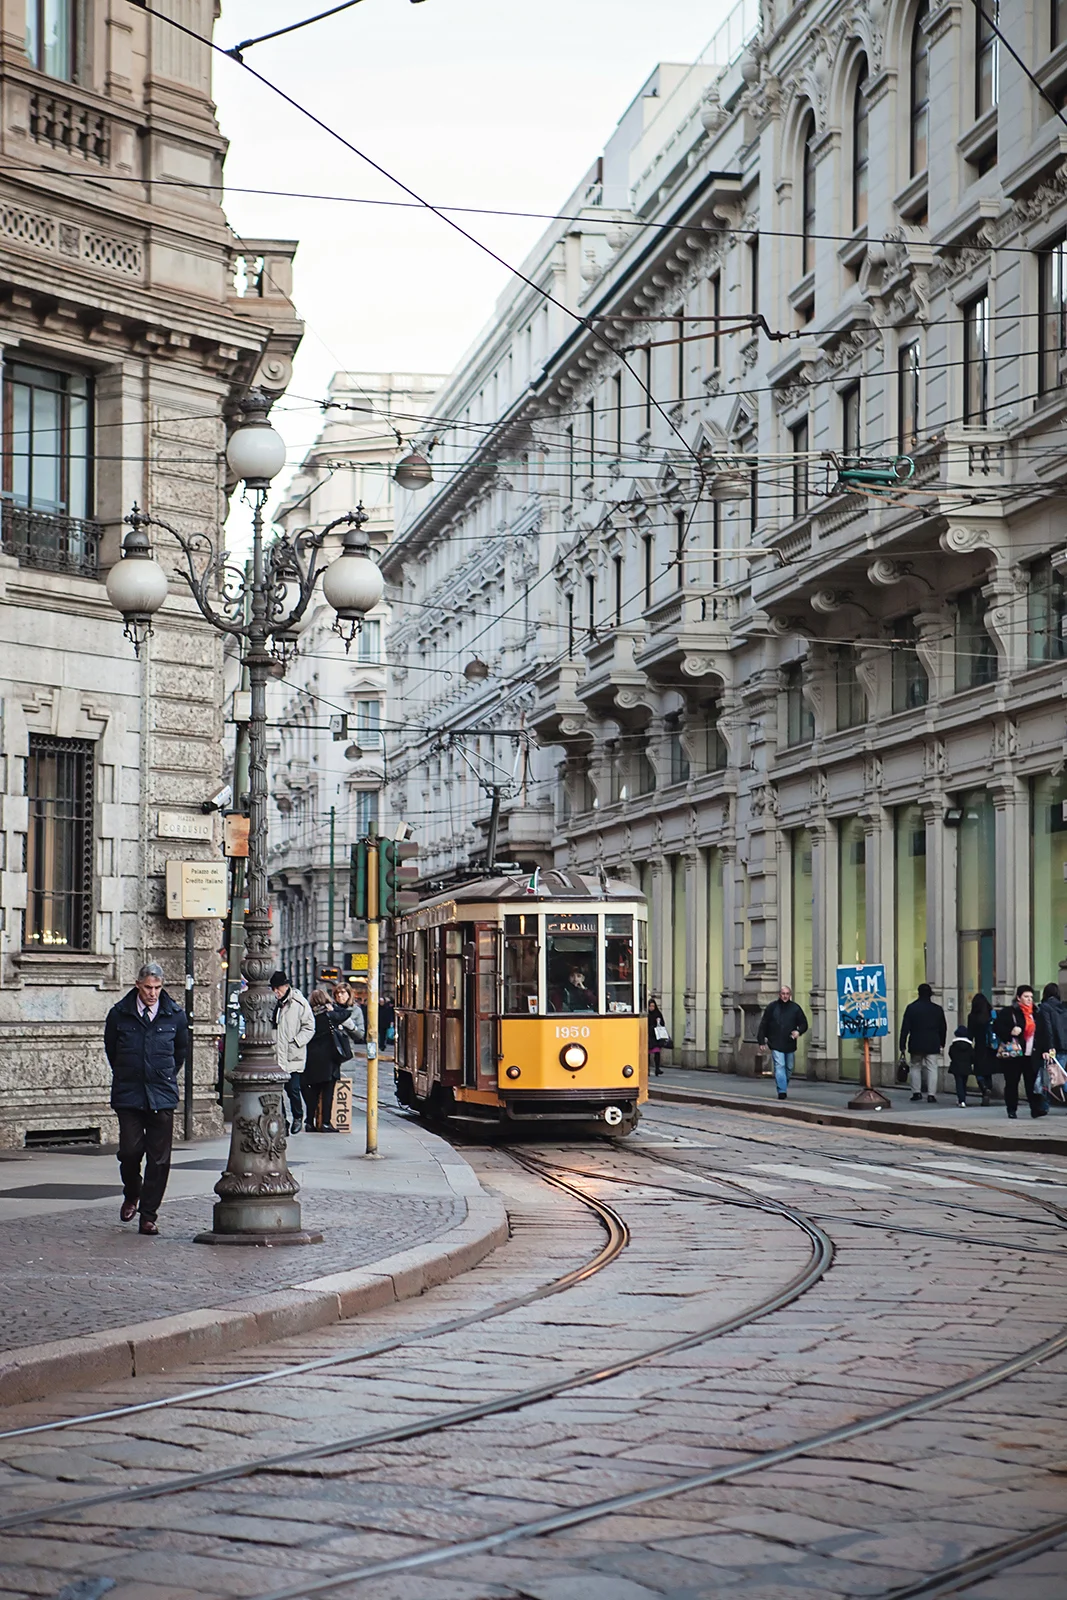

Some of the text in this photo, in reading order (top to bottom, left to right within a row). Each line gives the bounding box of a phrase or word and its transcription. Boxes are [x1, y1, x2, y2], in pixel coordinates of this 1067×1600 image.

[163, 823, 209, 834] CORDUSIO
[844, 975, 878, 994] ATM
[555, 1026, 590, 1038] 1950
[336, 1080, 351, 1132] Kartell
